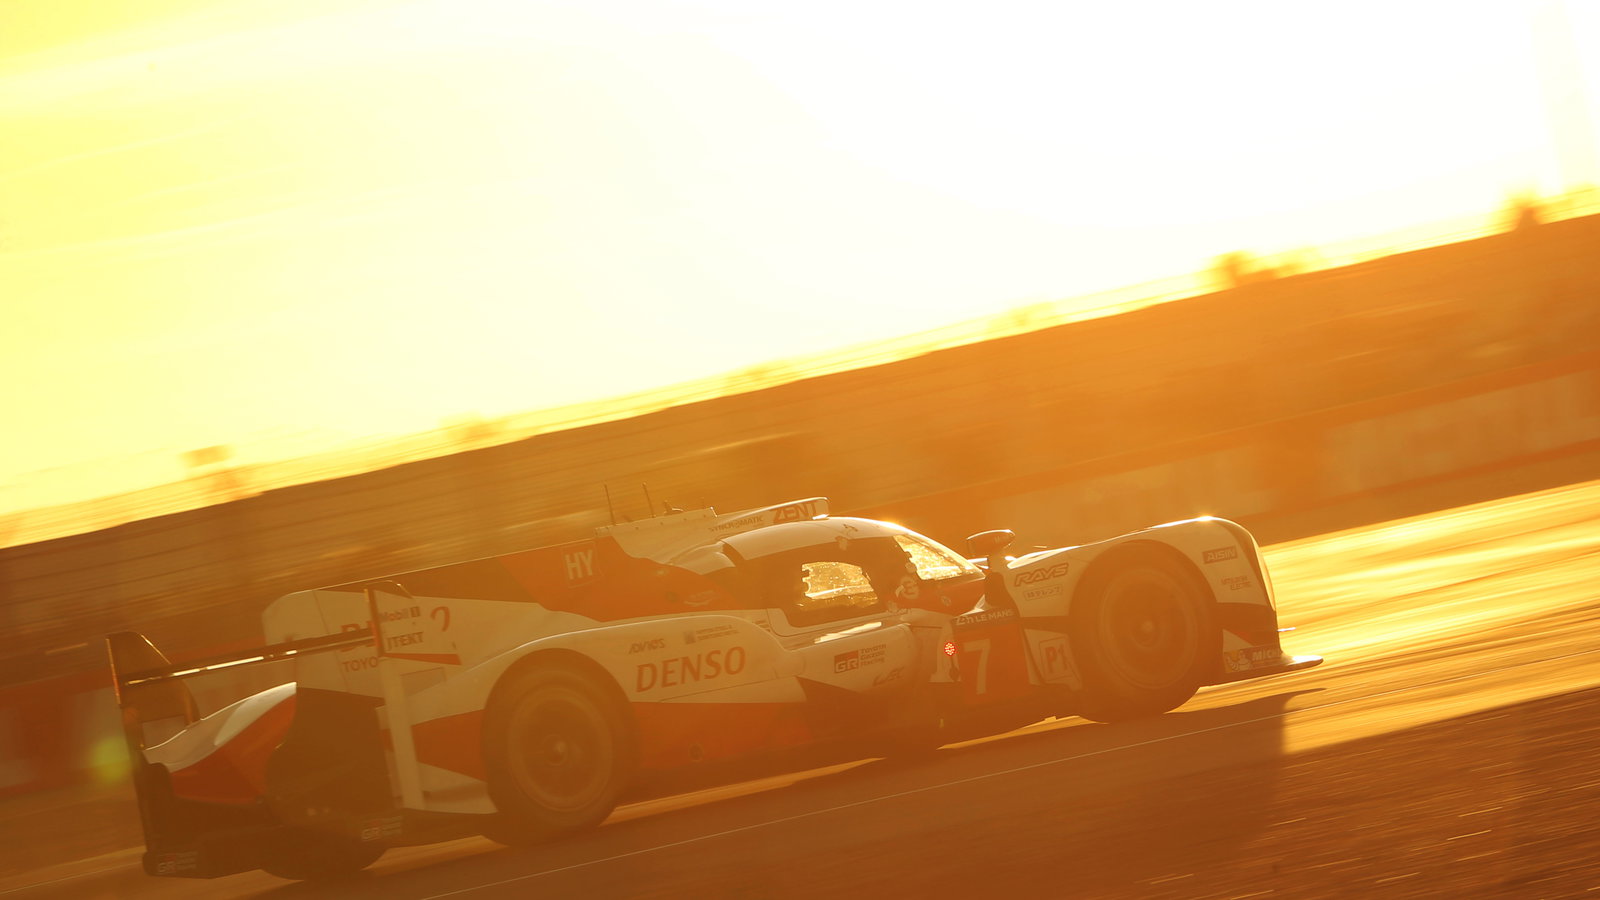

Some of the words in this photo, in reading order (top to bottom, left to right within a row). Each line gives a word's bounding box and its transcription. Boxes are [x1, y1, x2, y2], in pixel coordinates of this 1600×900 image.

[770, 500, 818, 524] ZENT
[564, 549, 593, 580] HY
[1206, 549, 1235, 561] AISIN
[1014, 562, 1069, 587] RAYS
[975, 614, 988, 623] LE
[988, 608, 1016, 621] MANS
[386, 632, 424, 652] JTEKT
[342, 656, 378, 673] TOYO
[635, 645, 746, 693] DENSO
[835, 658, 859, 673] GR
[962, 637, 991, 695] 7
[1045, 643, 1068, 674] P1
